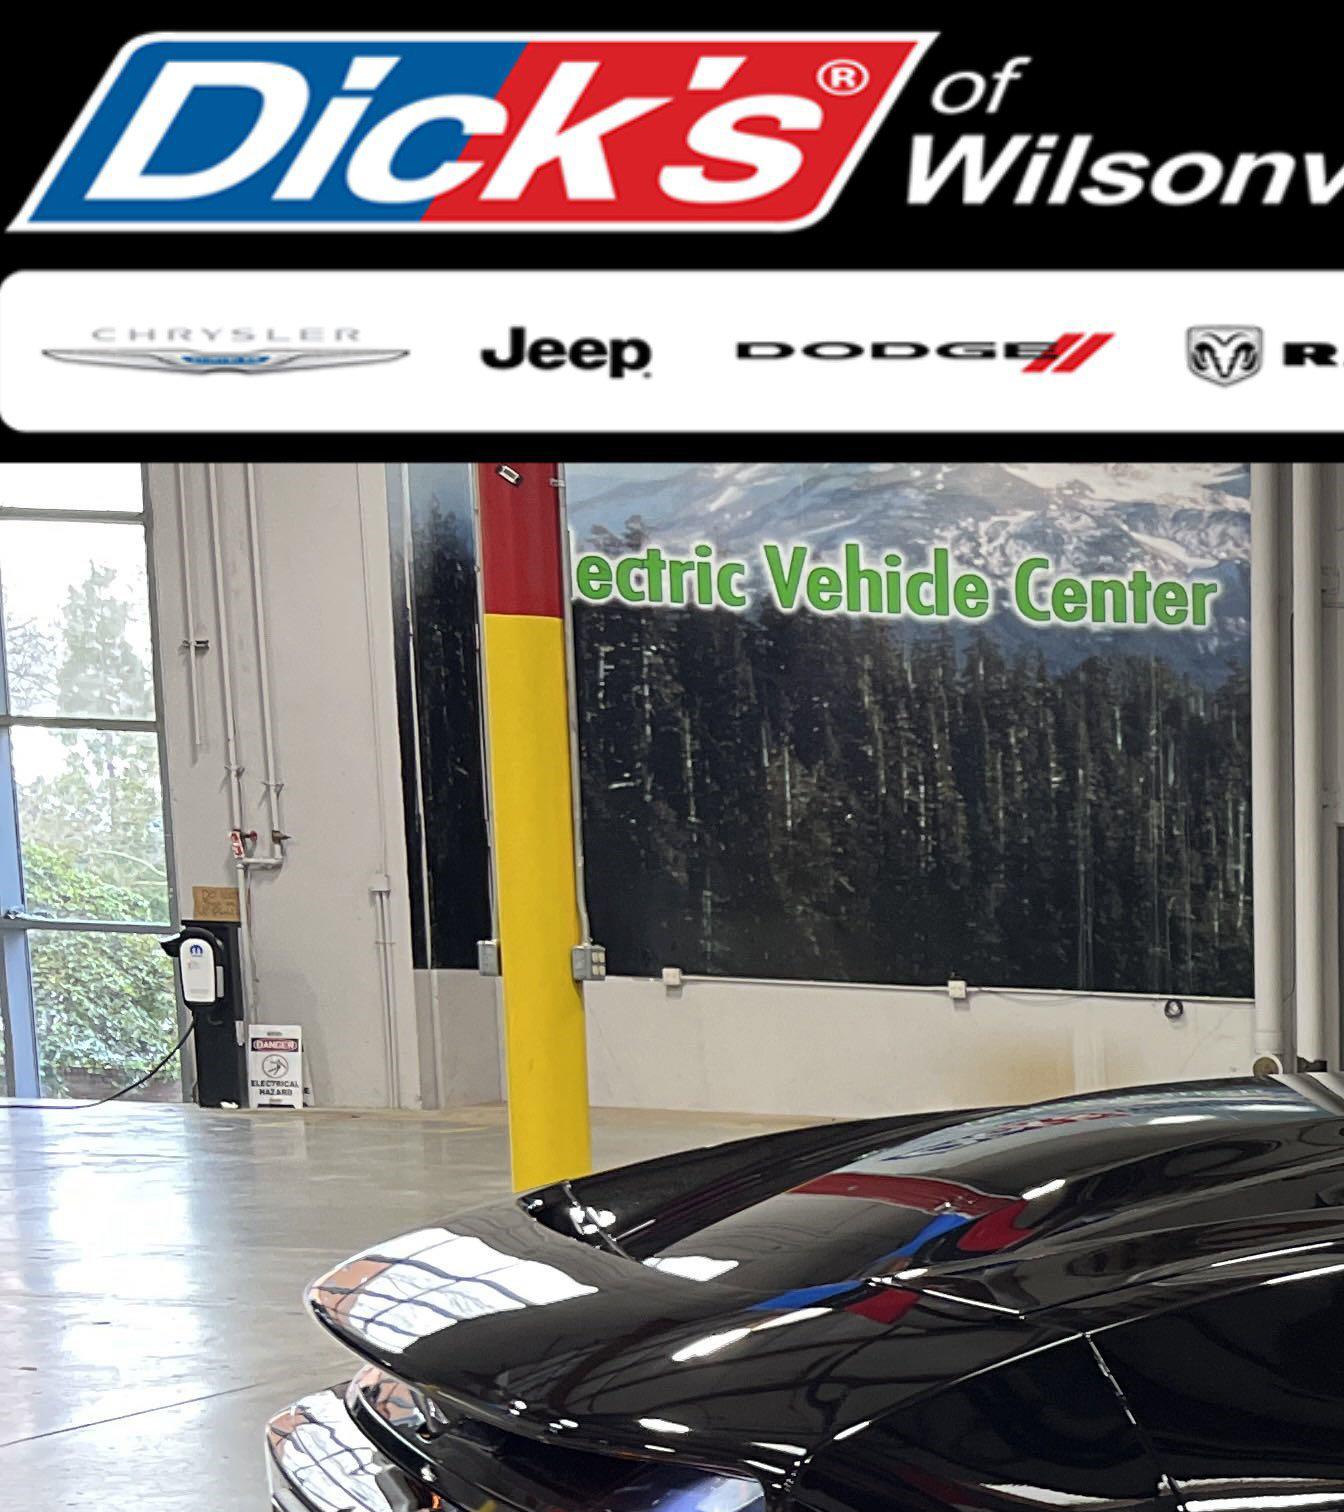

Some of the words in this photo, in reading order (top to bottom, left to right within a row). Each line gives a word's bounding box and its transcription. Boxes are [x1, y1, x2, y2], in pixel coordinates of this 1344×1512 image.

[764, 544, 988, 616] Vehicle
[1016, 559, 1217, 624] Center
[256, 1040, 295, 1049] DANGER
[251, 1080, 299, 1088] ELECTRICAL
